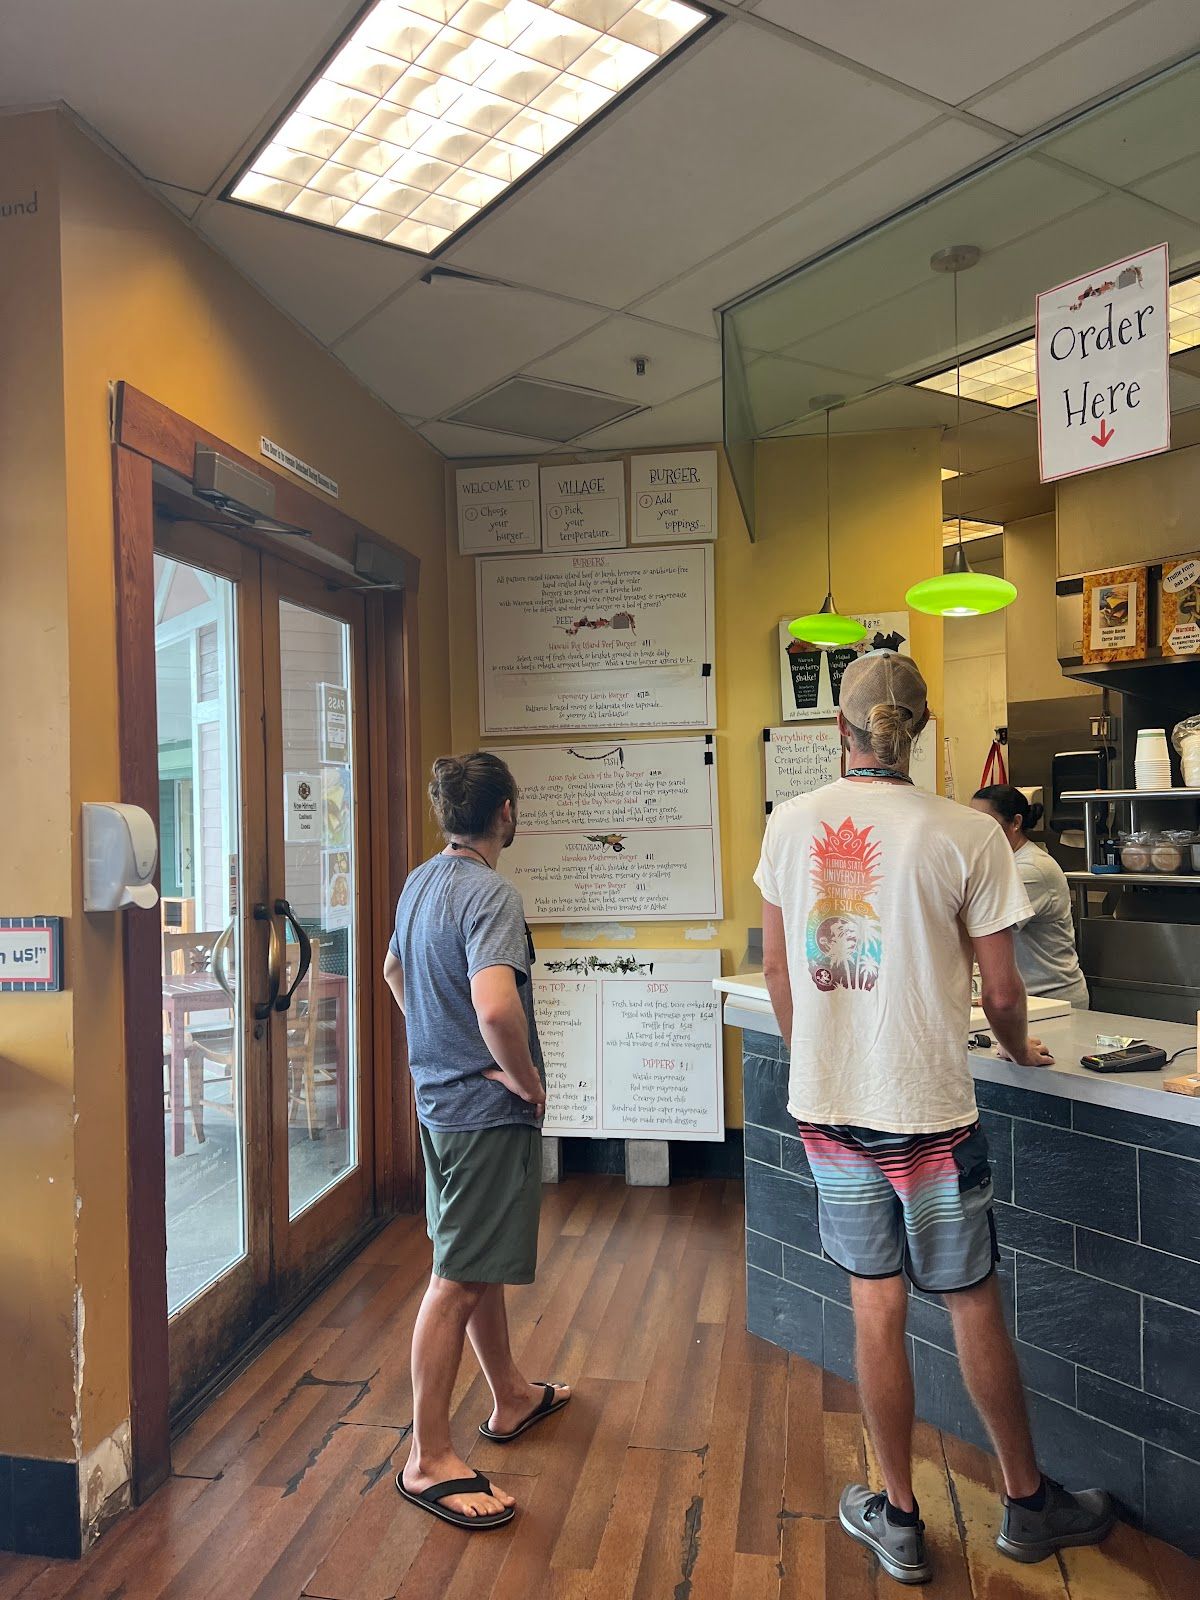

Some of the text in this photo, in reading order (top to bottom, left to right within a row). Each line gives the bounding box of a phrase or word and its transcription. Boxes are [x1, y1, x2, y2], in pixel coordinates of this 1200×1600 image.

[1050, 303, 1154, 361] Order
[1063, 381, 1141, 428] Here
[649, 467, 701, 484] BURGER
[462, 479, 530, 494] WELCOME TO
[558, 477, 605, 494] VILLAGE
[655, 492, 672, 505] Add
[480, 506, 507, 517] Choose
[565, 503, 583, 515] Pick
[657, 508, 679, 520] your
[488, 520, 508, 532] your
[564, 519, 584, 531] your
[556, 615, 573, 624] BEEF
[792, 664, 820, 672] Strawberry
[771, 732, 813, 745] Everything
[777, 743, 828, 754] Root beer float
[603, 757, 619, 766] FISH
[816, 754, 831, 765] float
[778, 765, 828, 776] Bottled drinks
[566, 843, 602, 852] VEGETARIAN
[848, 860, 864, 871] STATE
[823, 868, 866, 885] UNIVERSITY
[828, 887, 862, 901] SEMINOLES
[835, 900, 852, 912] FSU
[647, 983, 669, 994] SIDES
[642, 1058, 676, 1071] DIPPERS
